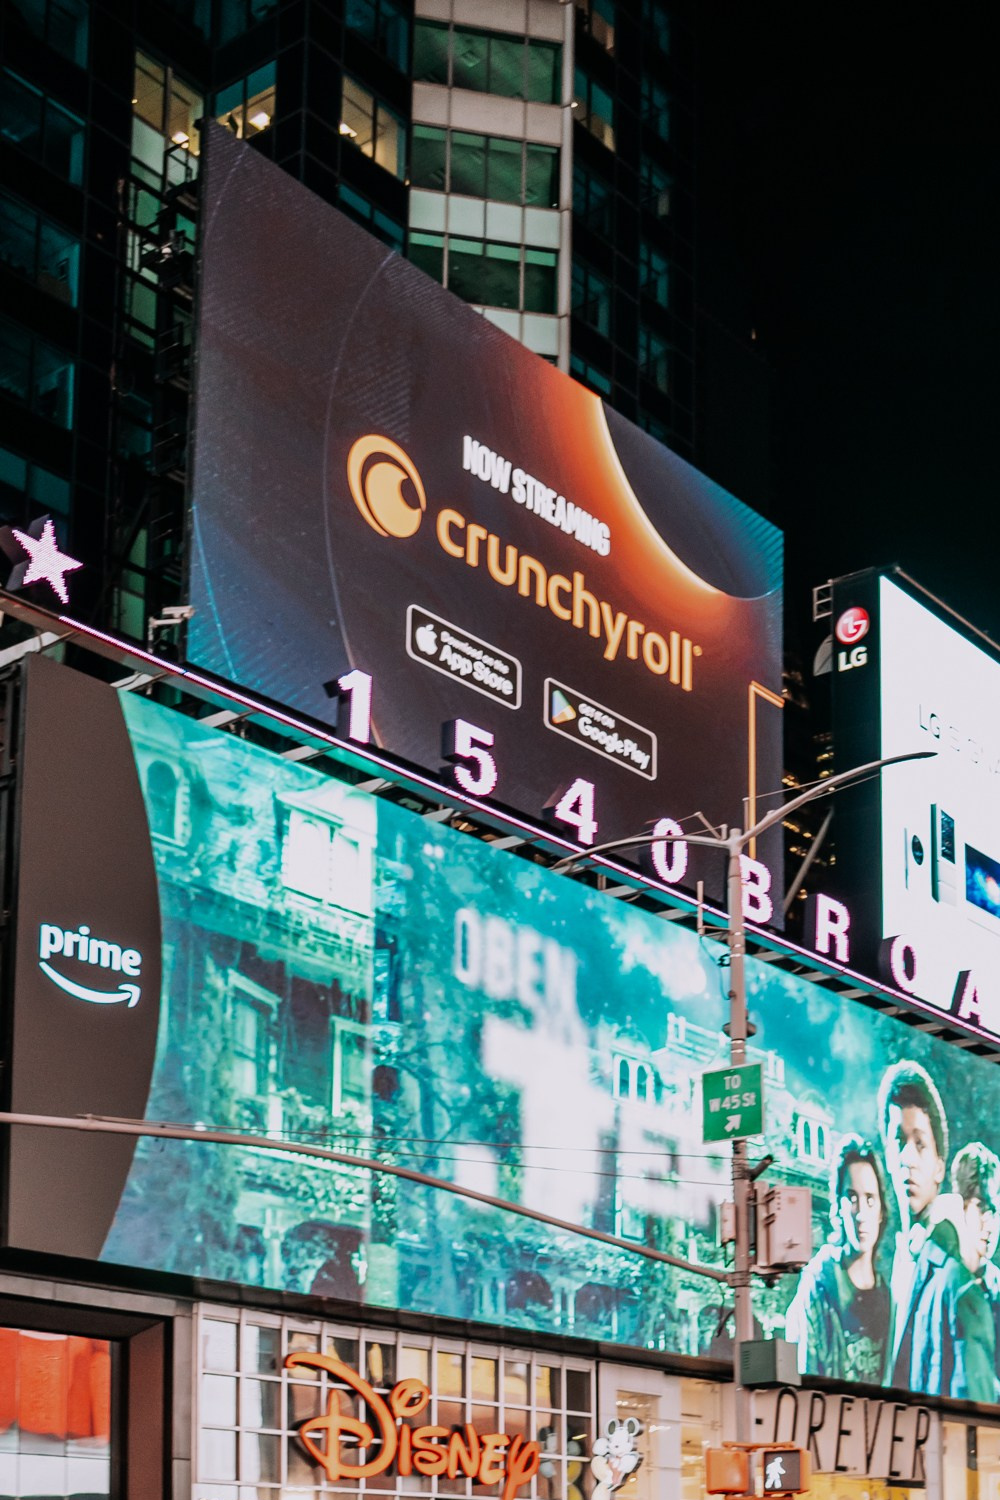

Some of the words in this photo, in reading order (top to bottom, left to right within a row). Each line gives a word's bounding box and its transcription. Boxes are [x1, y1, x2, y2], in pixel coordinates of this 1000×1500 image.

[463, 435, 512, 493] NOW
[511, 468, 611, 557] STREAMING
[436, 508, 693, 692] crunchyroll
[439, 644, 473, 676] App
[472, 661, 513, 695] Store
[838, 647, 868, 672] LG
[578, 716, 624, 753] Google
[623, 739, 650, 770] Play
[919, 704, 941, 739] LG
[338, 669, 688, 884] 1540
[40, 923, 142, 977] prime
[709, 1098, 721, 1113] W
[721, 1094, 740, 1110] 45
[742, 1092, 756, 1107] St
[723, 1075, 742, 1090] TO
